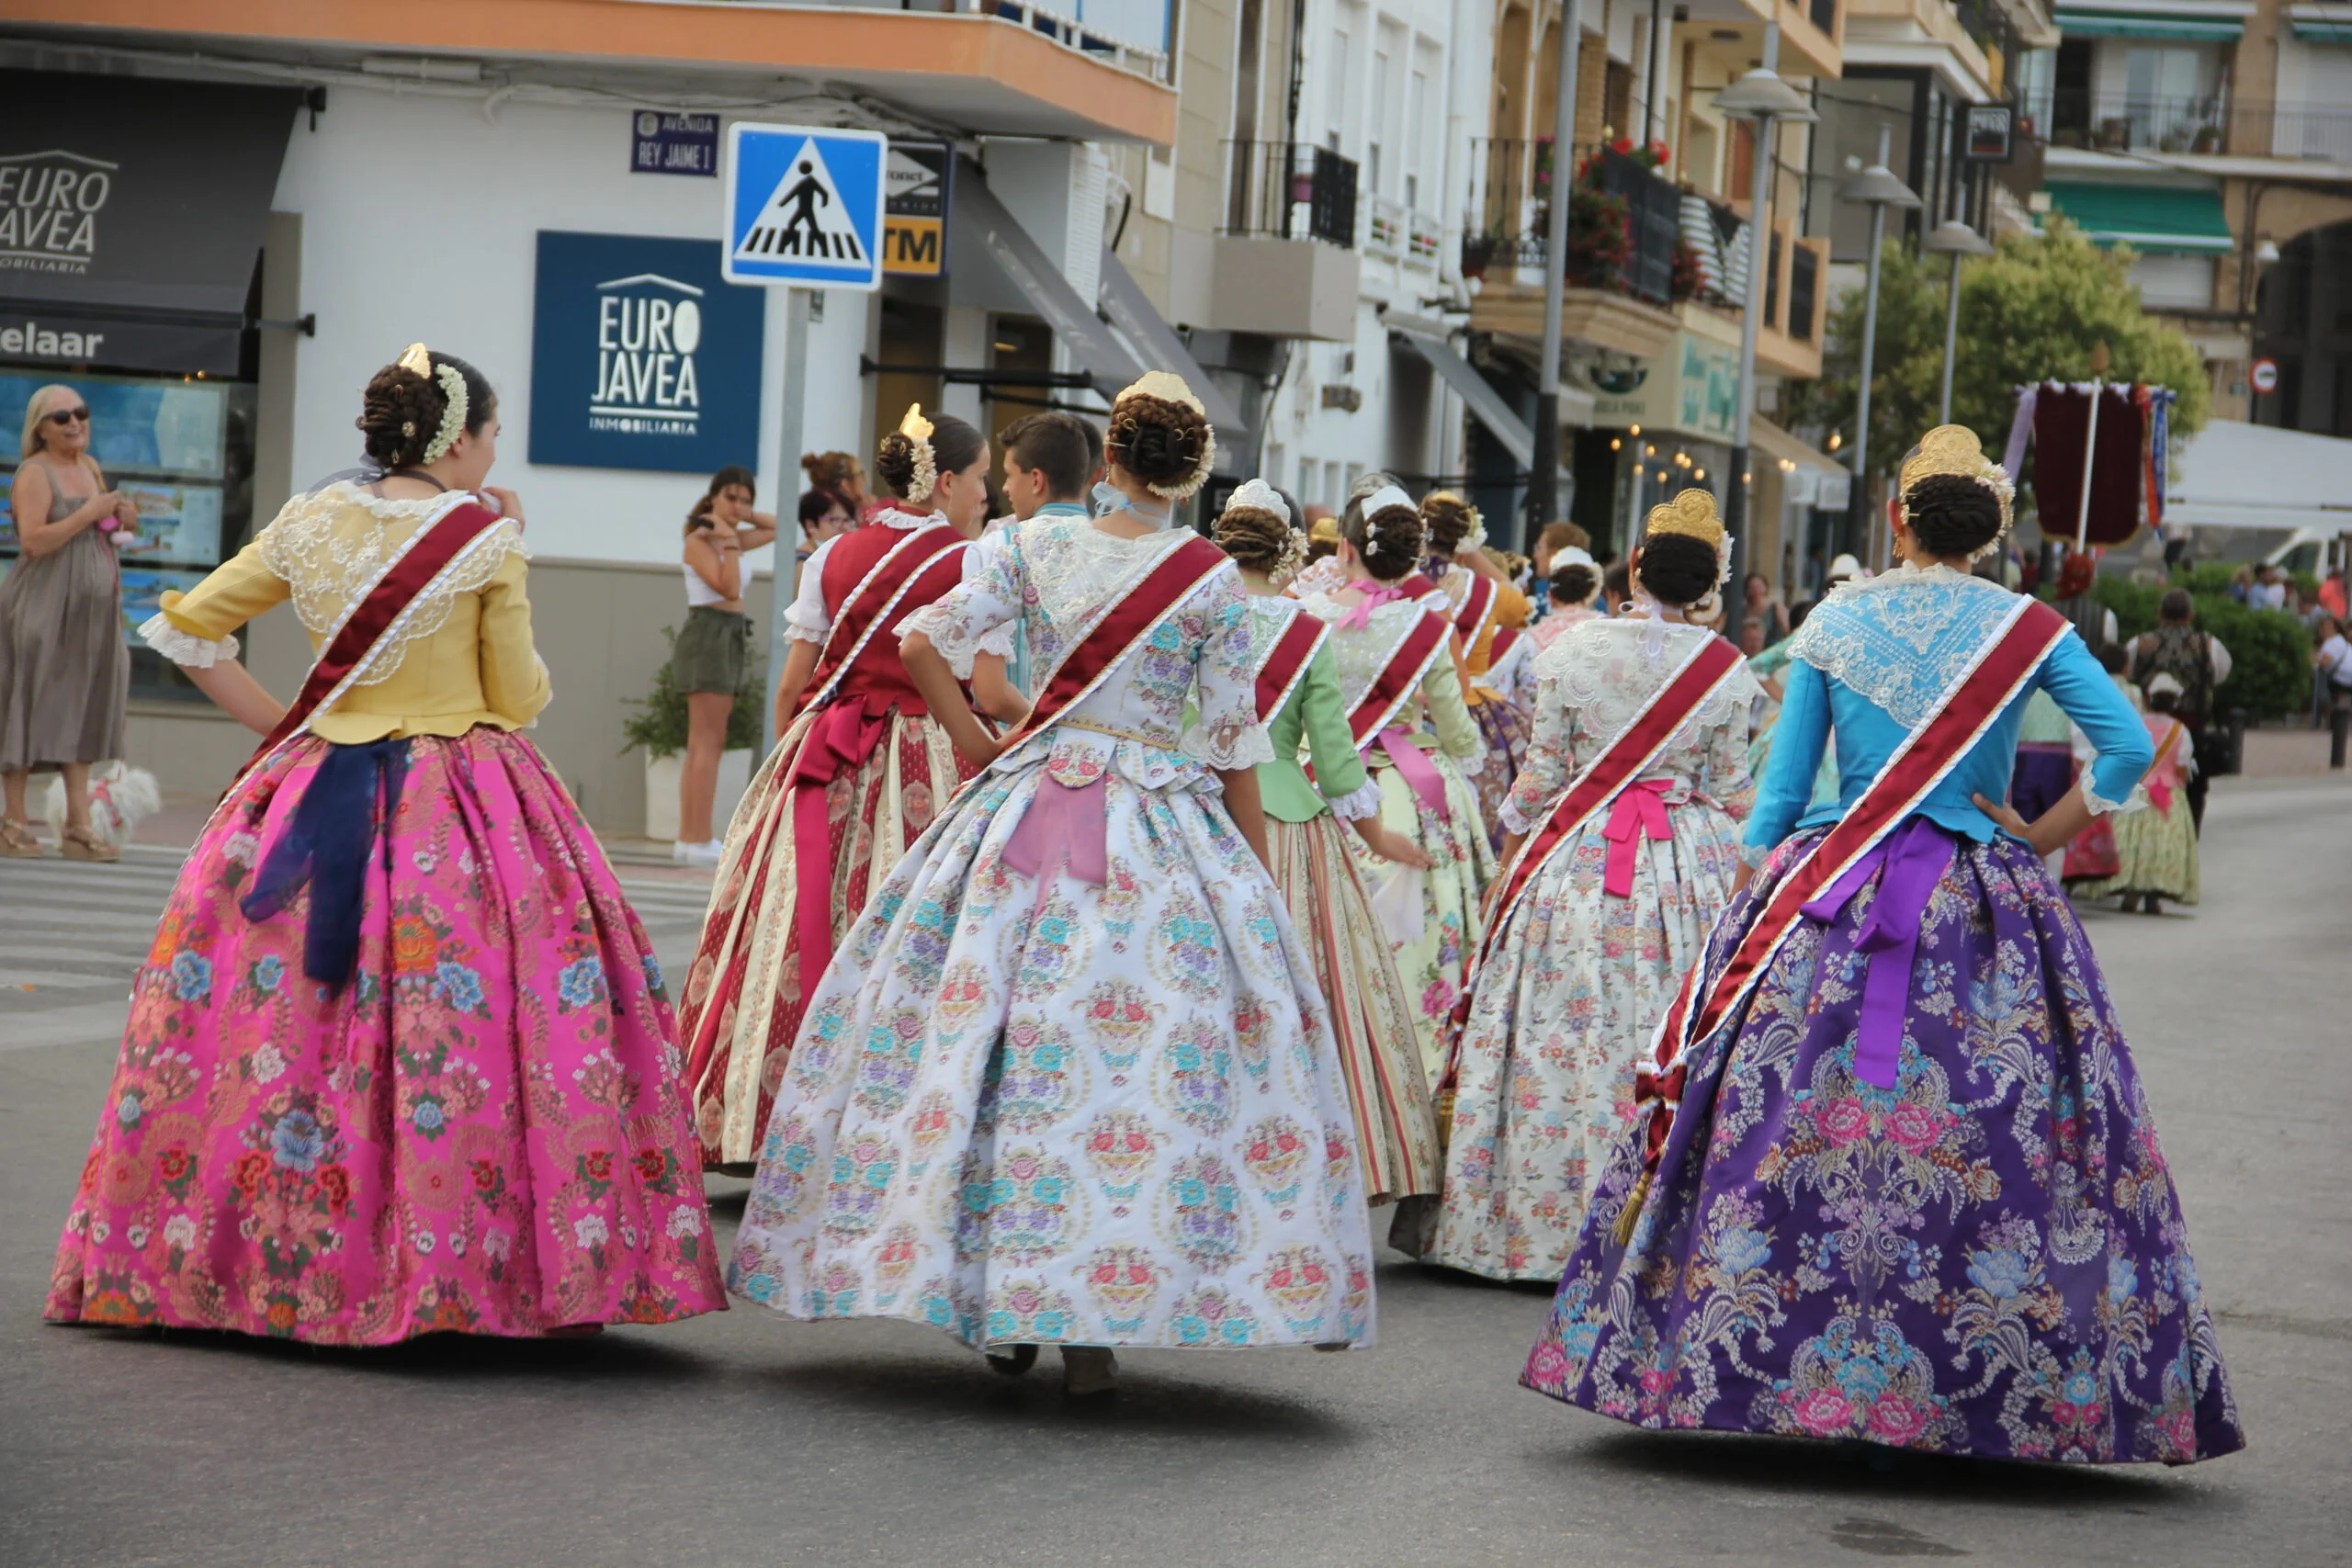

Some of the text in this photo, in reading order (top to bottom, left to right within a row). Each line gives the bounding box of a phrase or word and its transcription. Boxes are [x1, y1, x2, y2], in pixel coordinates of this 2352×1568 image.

[662, 116, 714, 132] AVENIDA
[639, 141, 662, 165] REY
[665, 143, 700, 169] JAIME
[0, 166, 109, 212] EURO
[0, 321, 104, 357] elaar
[599, 296, 701, 355] EURO
[591, 350, 699, 408] JAVEA
[589, 417, 697, 435] INMOBILIARIA
